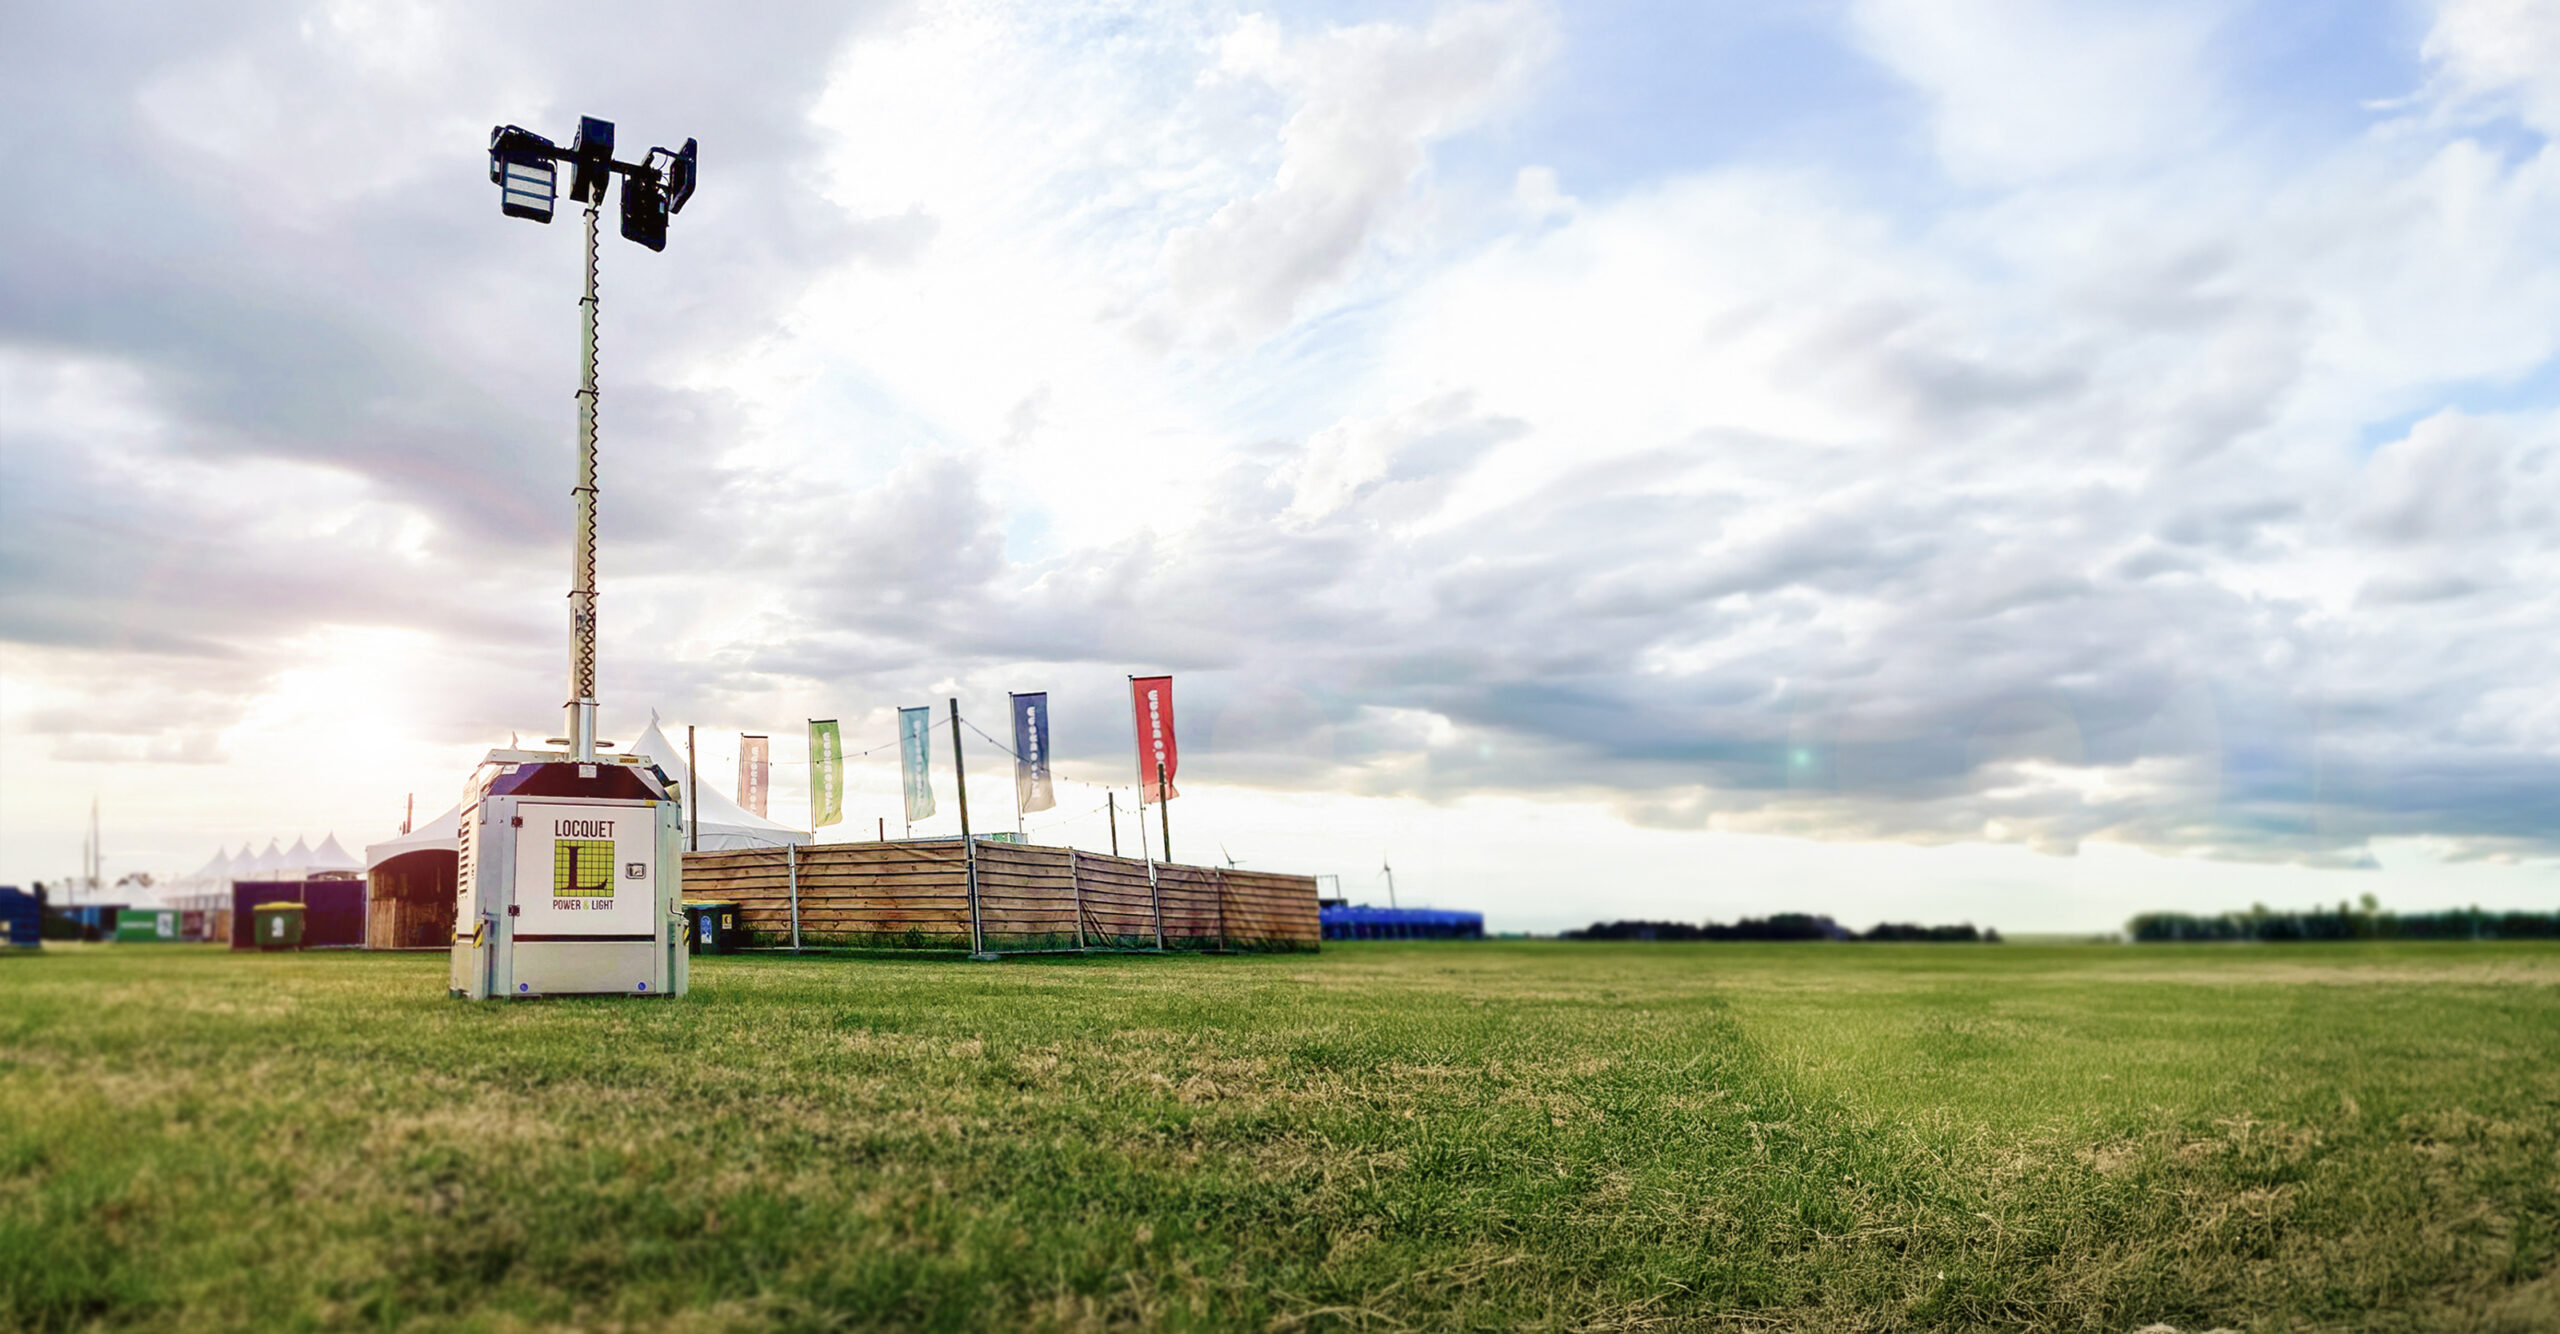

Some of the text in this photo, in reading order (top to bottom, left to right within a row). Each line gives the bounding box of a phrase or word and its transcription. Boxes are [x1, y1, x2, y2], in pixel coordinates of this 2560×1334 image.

[555, 820, 615, 837] LOCQUET
[561, 846, 608, 889] L
[553, 900, 581, 910] POWER
[592, 900, 614, 910] LIGHT
